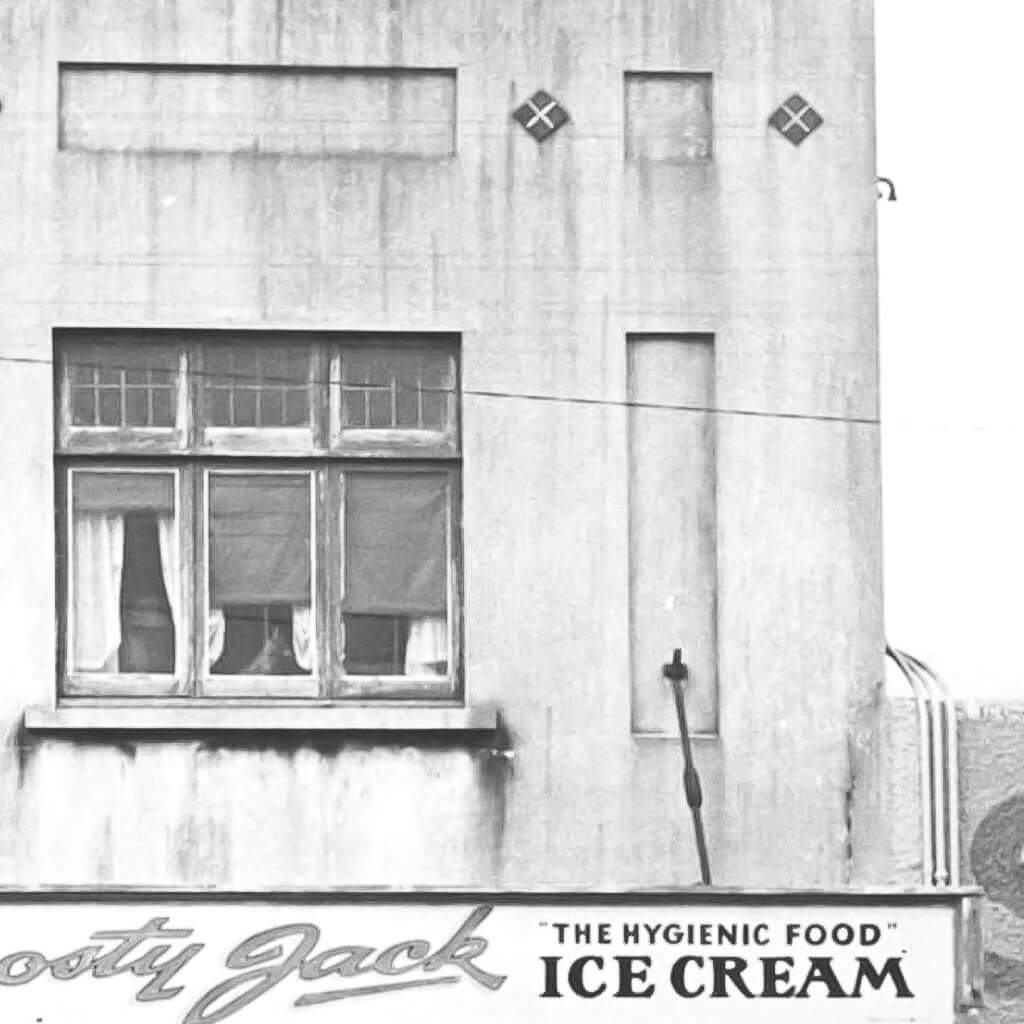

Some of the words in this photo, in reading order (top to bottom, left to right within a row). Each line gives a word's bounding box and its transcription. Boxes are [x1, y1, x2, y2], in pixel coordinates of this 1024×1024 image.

[623, 922, 770, 946] HYGIENIC
[539, 956, 655, 998] ICE
[670, 956, 914, 998] CREAM
